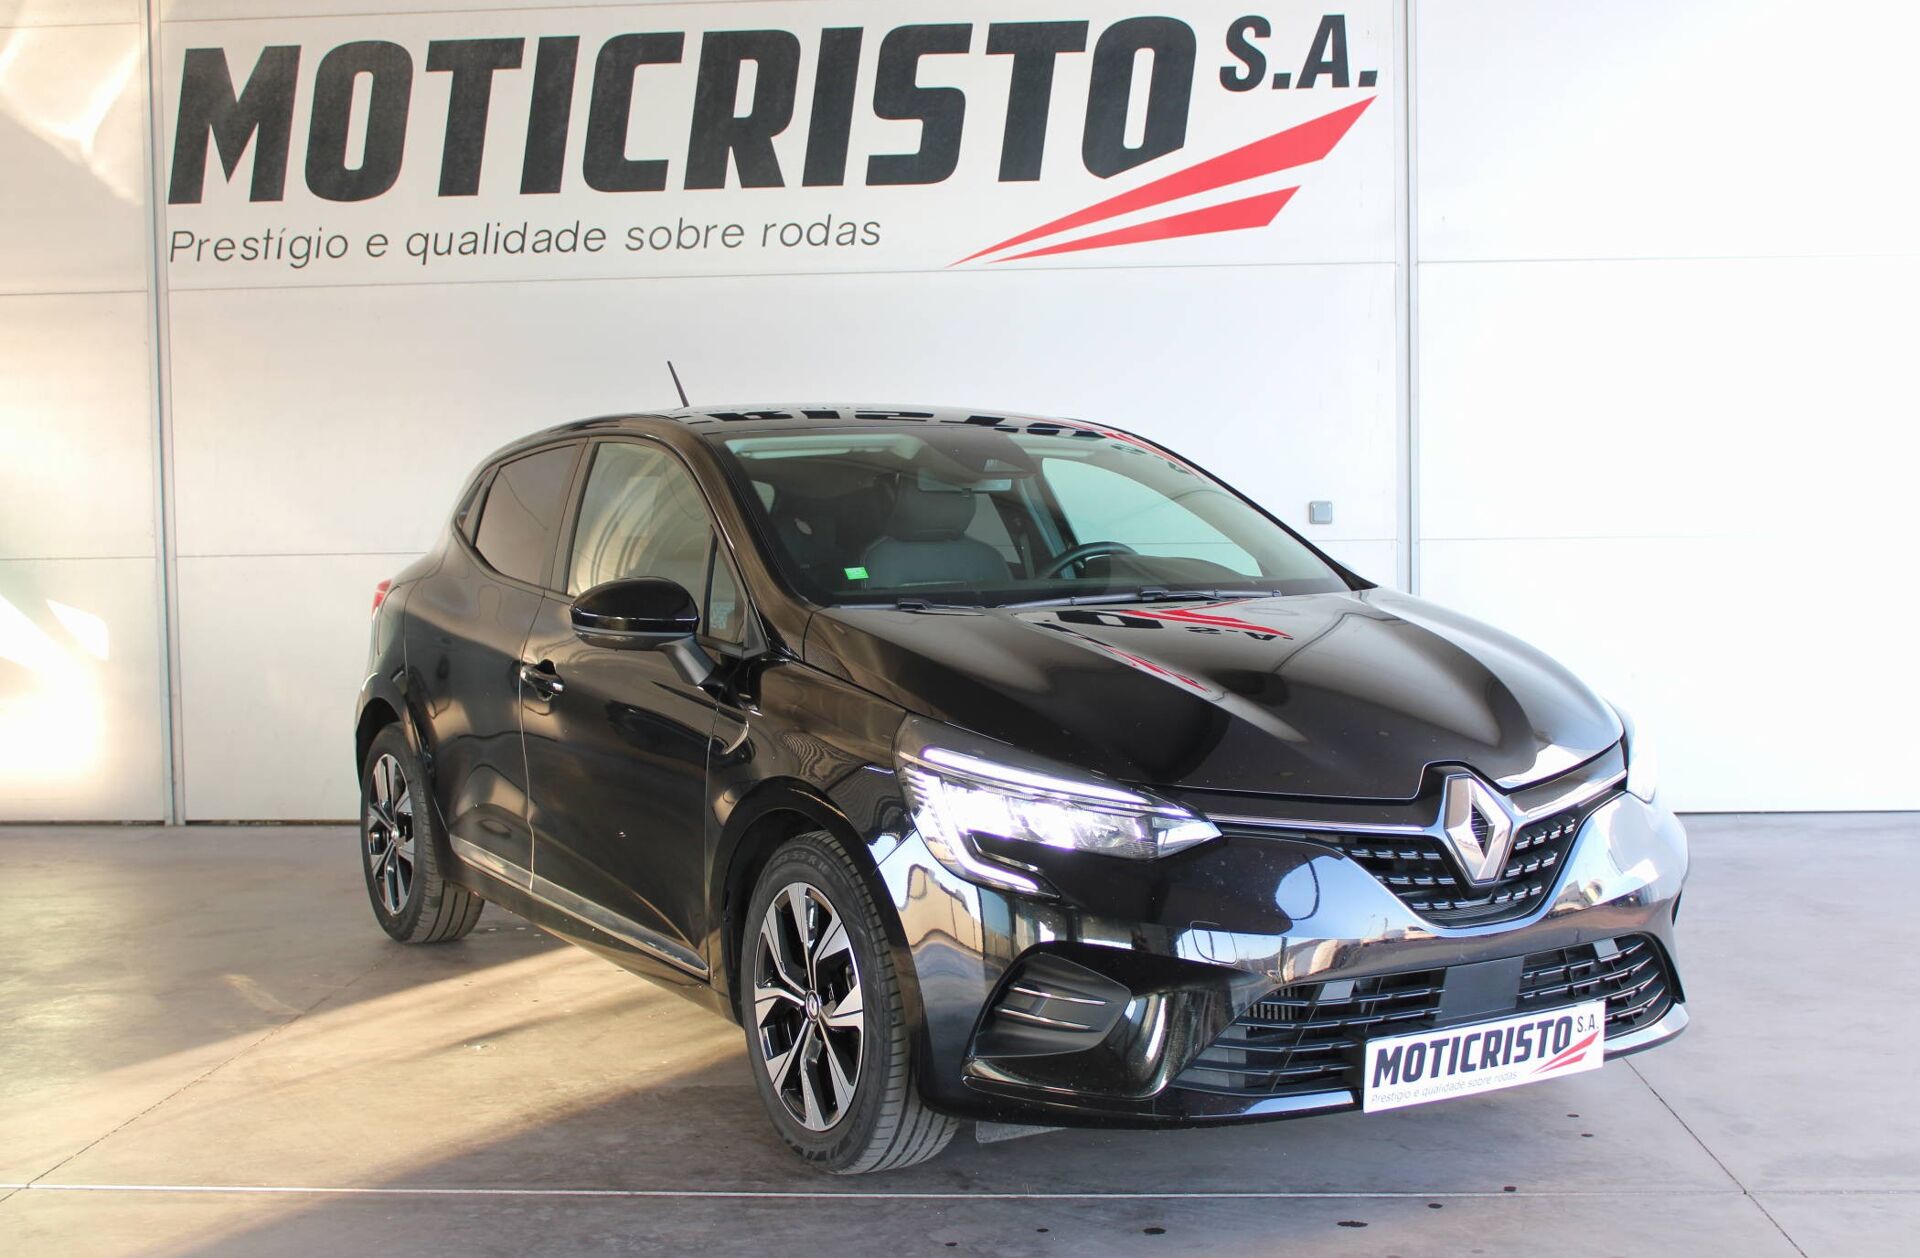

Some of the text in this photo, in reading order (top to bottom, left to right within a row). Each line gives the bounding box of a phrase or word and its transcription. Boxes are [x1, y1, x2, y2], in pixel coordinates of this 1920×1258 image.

[168, 14, 1378, 205] MOTICRISTO S.A.
[169, 213, 881, 269] Prestígio e qualidade sobre rodas
[1373, 1013, 1600, 1088] MOTICRISTO S.A.
